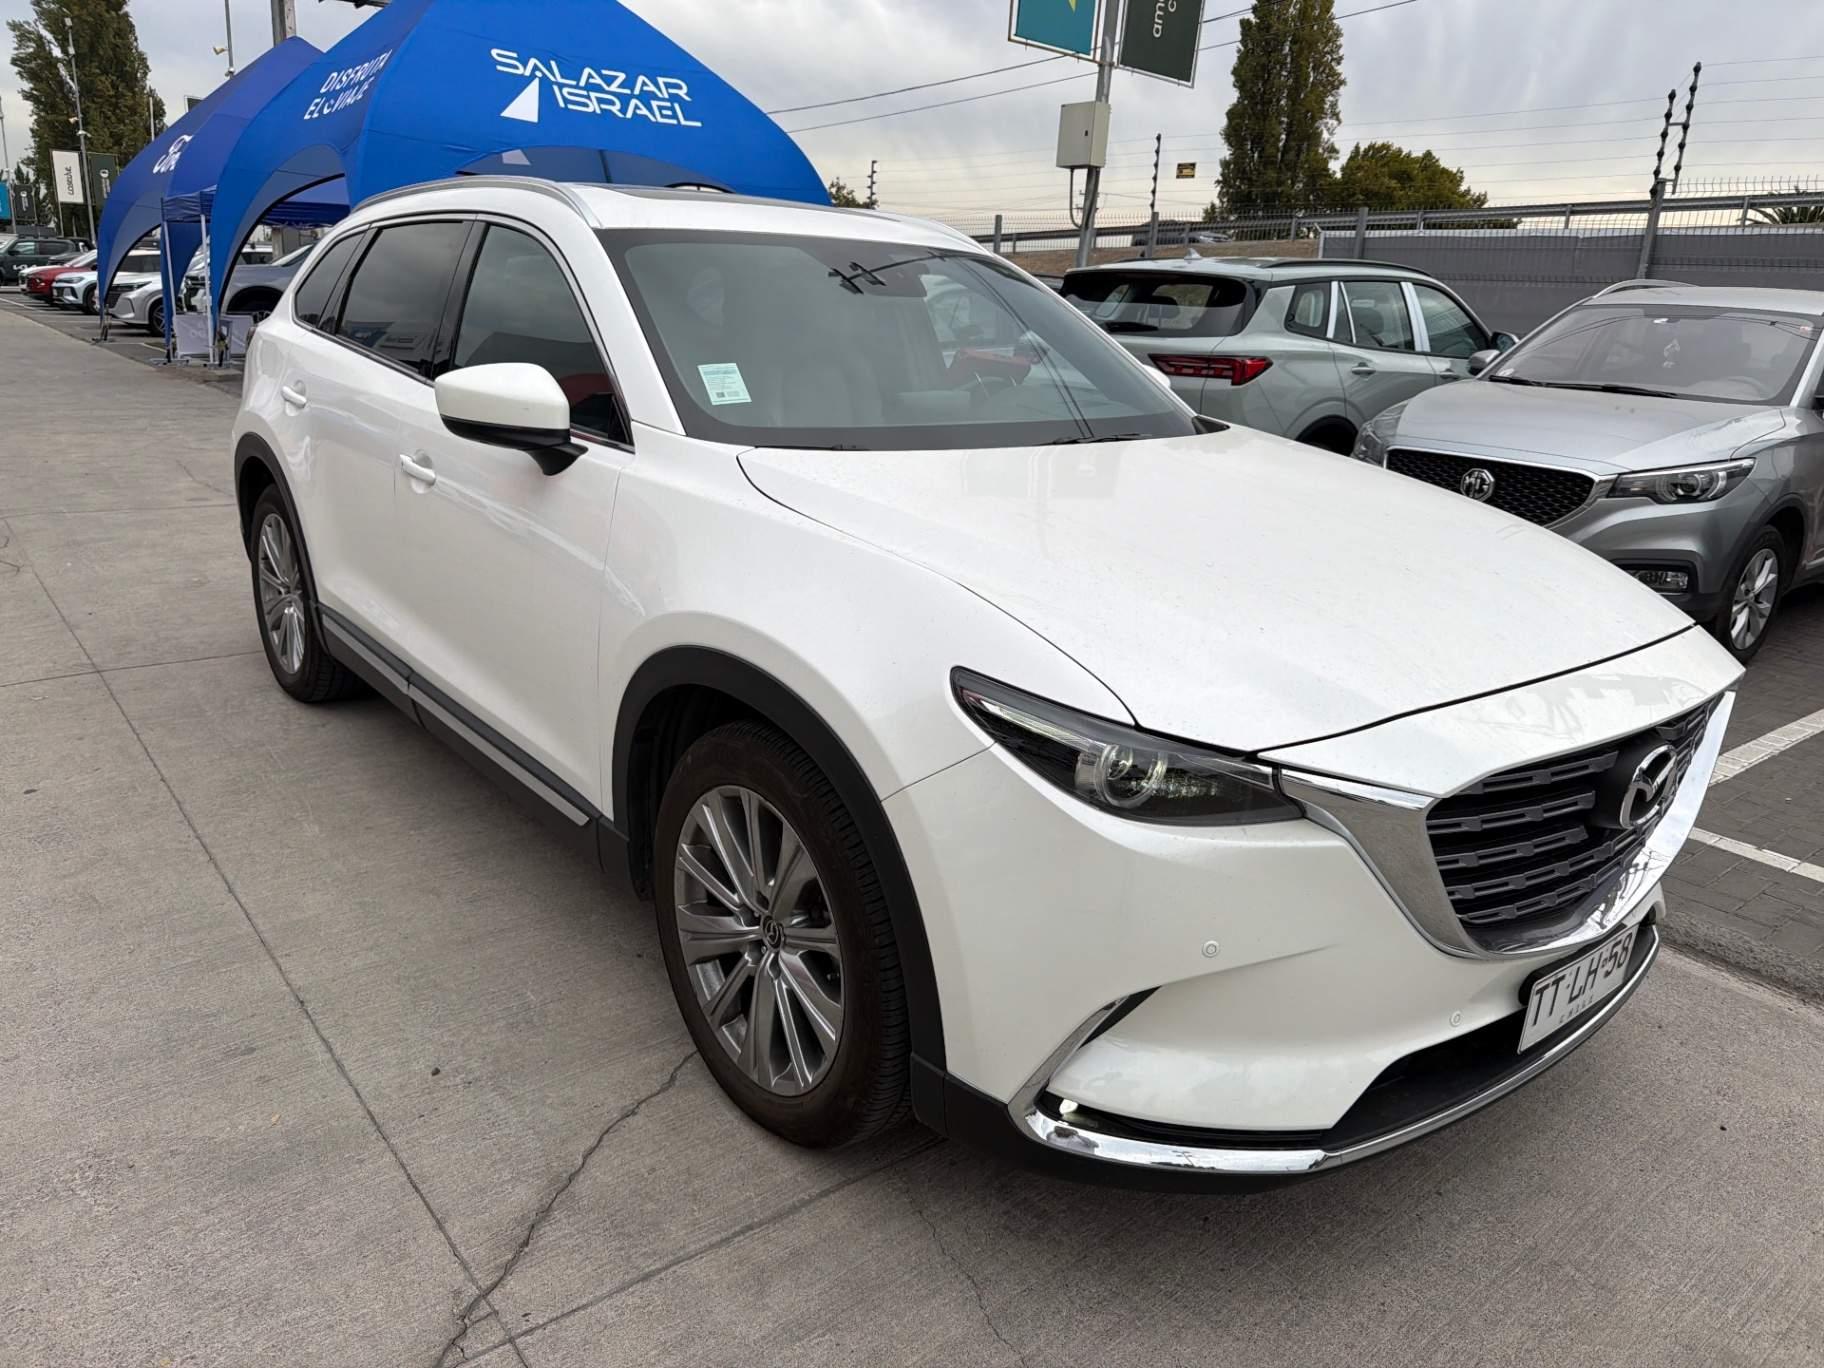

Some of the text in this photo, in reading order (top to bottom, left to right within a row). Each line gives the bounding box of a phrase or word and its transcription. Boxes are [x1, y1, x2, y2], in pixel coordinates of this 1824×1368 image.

[1152, 0, 1165, 38] am
[319, 48, 393, 94] DISFRUTA
[490, 48, 693, 101] SALAZAR
[303, 96, 327, 120] EL
[553, 84, 703, 127] ISRAEL
[1462, 471, 1490, 499] MG
